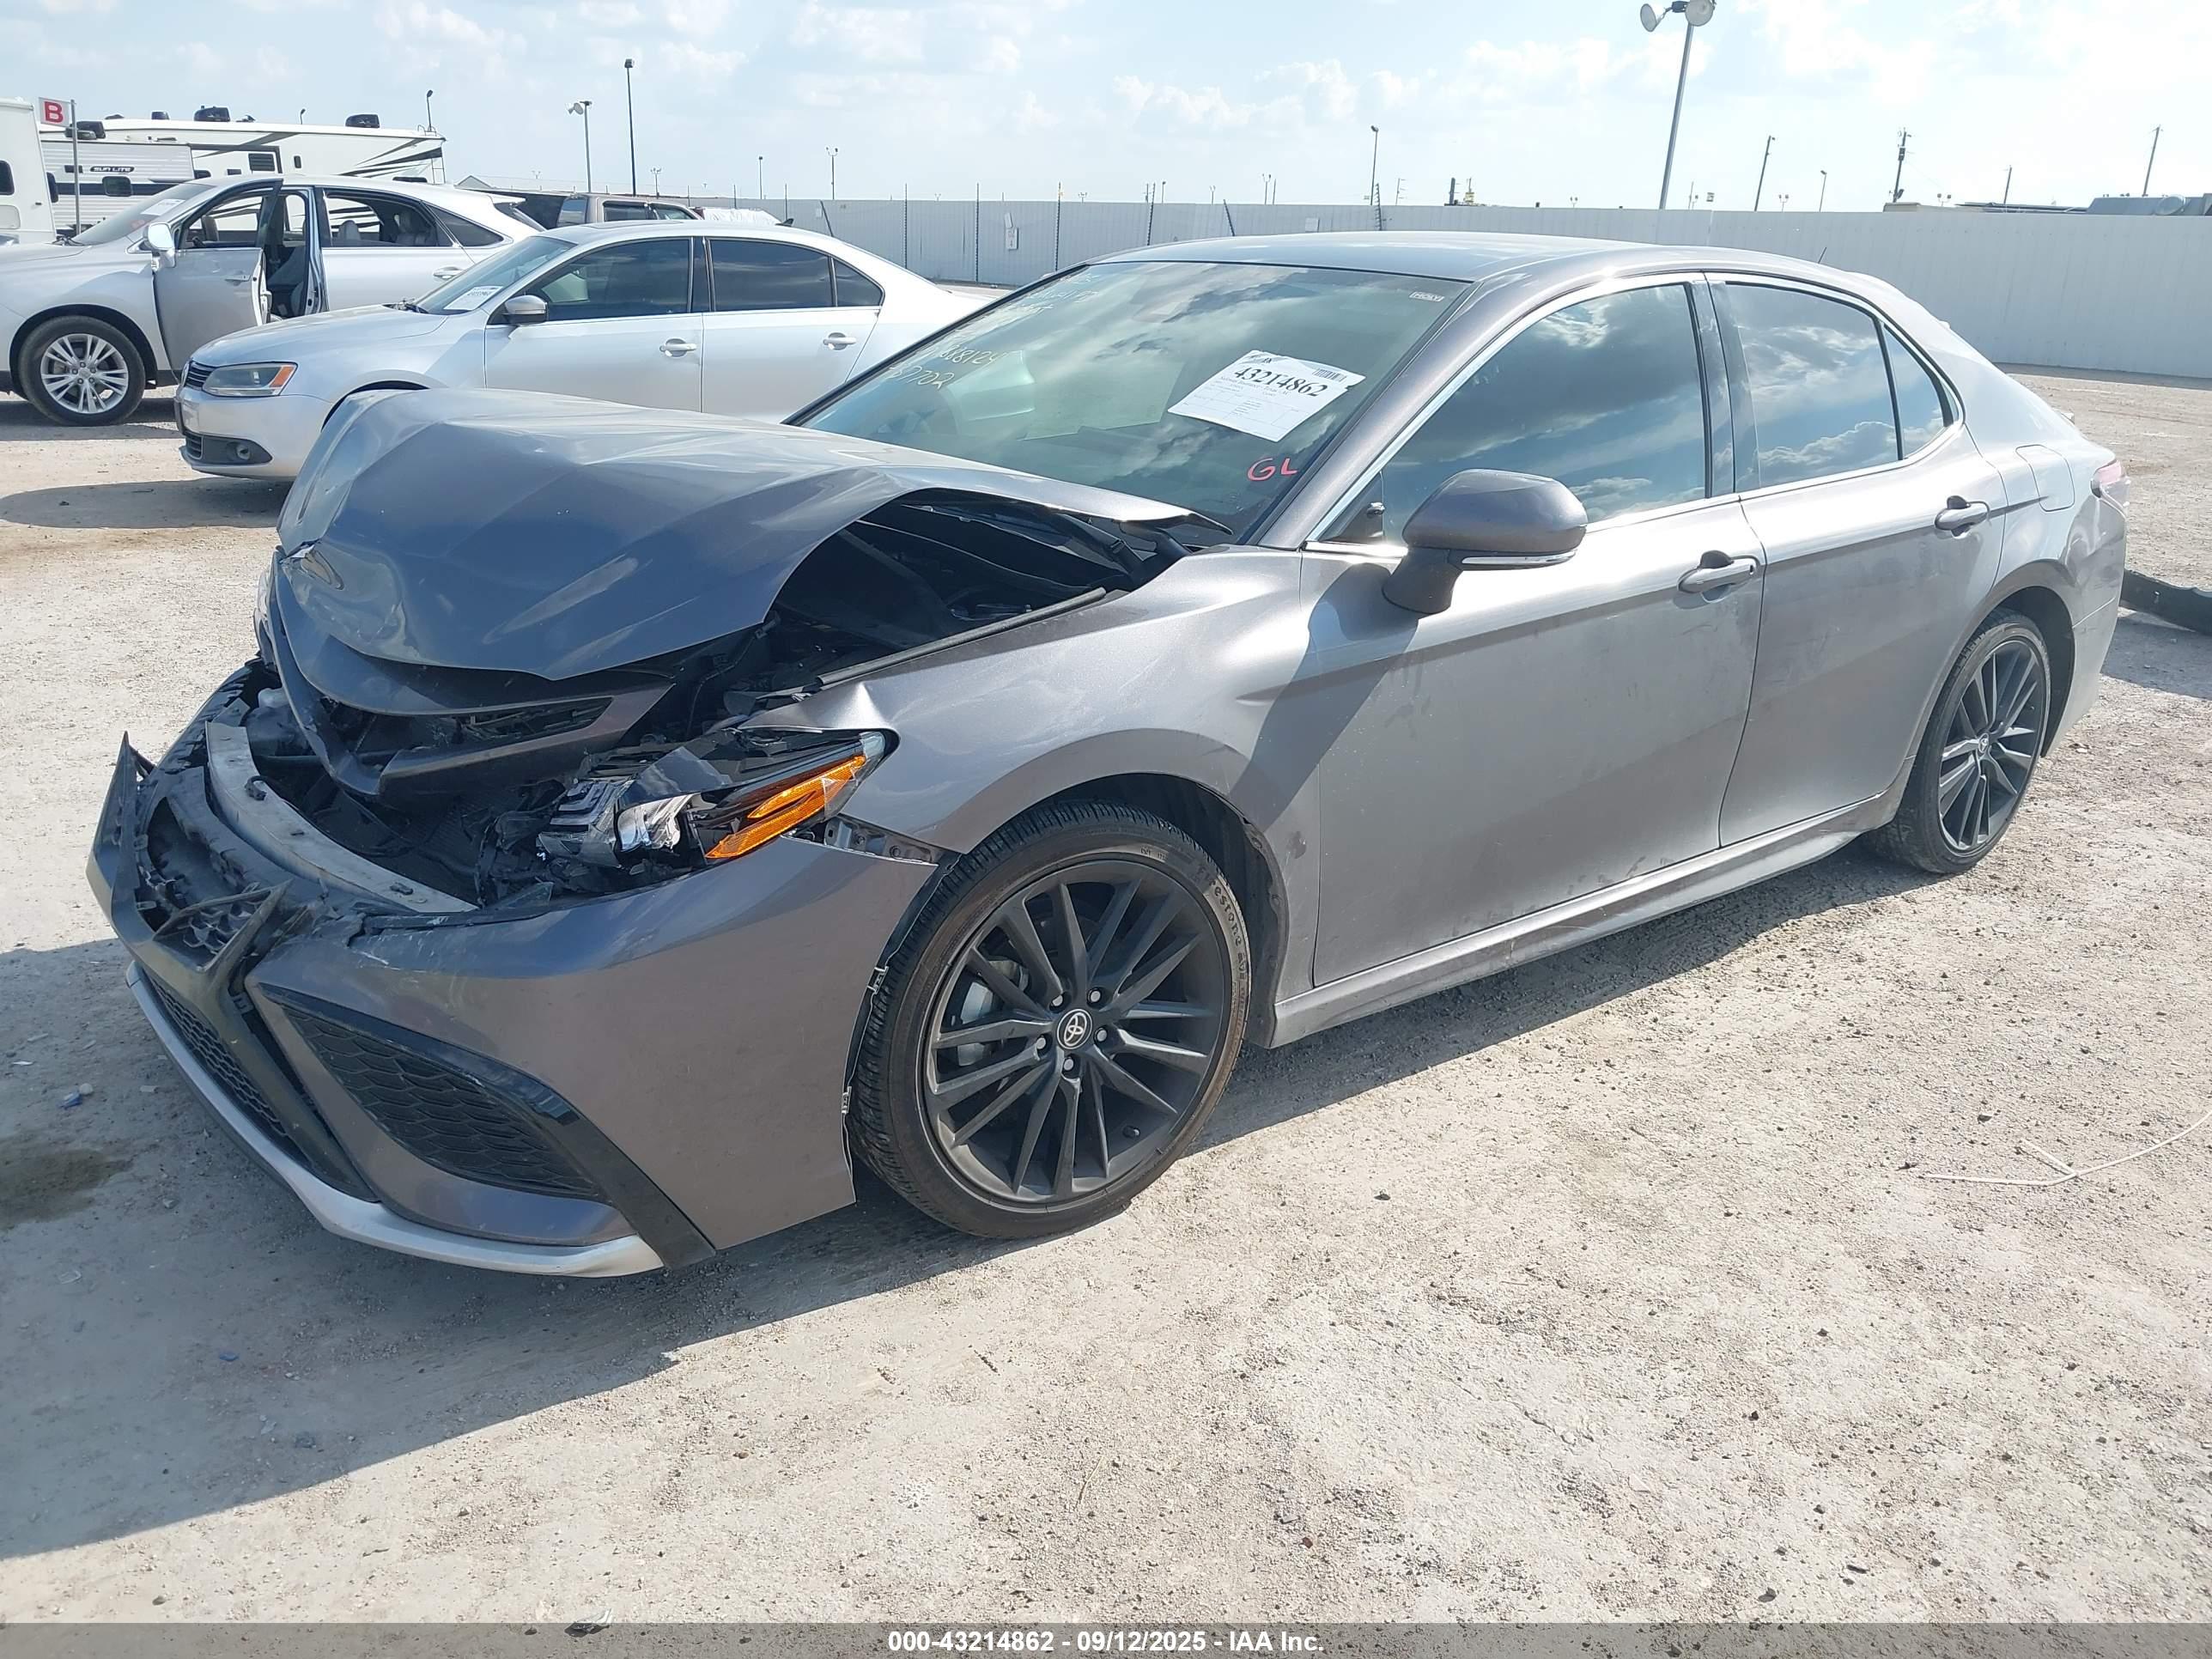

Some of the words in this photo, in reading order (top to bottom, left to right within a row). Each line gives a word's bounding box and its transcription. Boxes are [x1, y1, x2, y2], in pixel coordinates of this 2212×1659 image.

[44, 100, 64, 123] B
[1235, 366, 1328, 397] 43214862
[1247, 457, 1299, 481] GL
